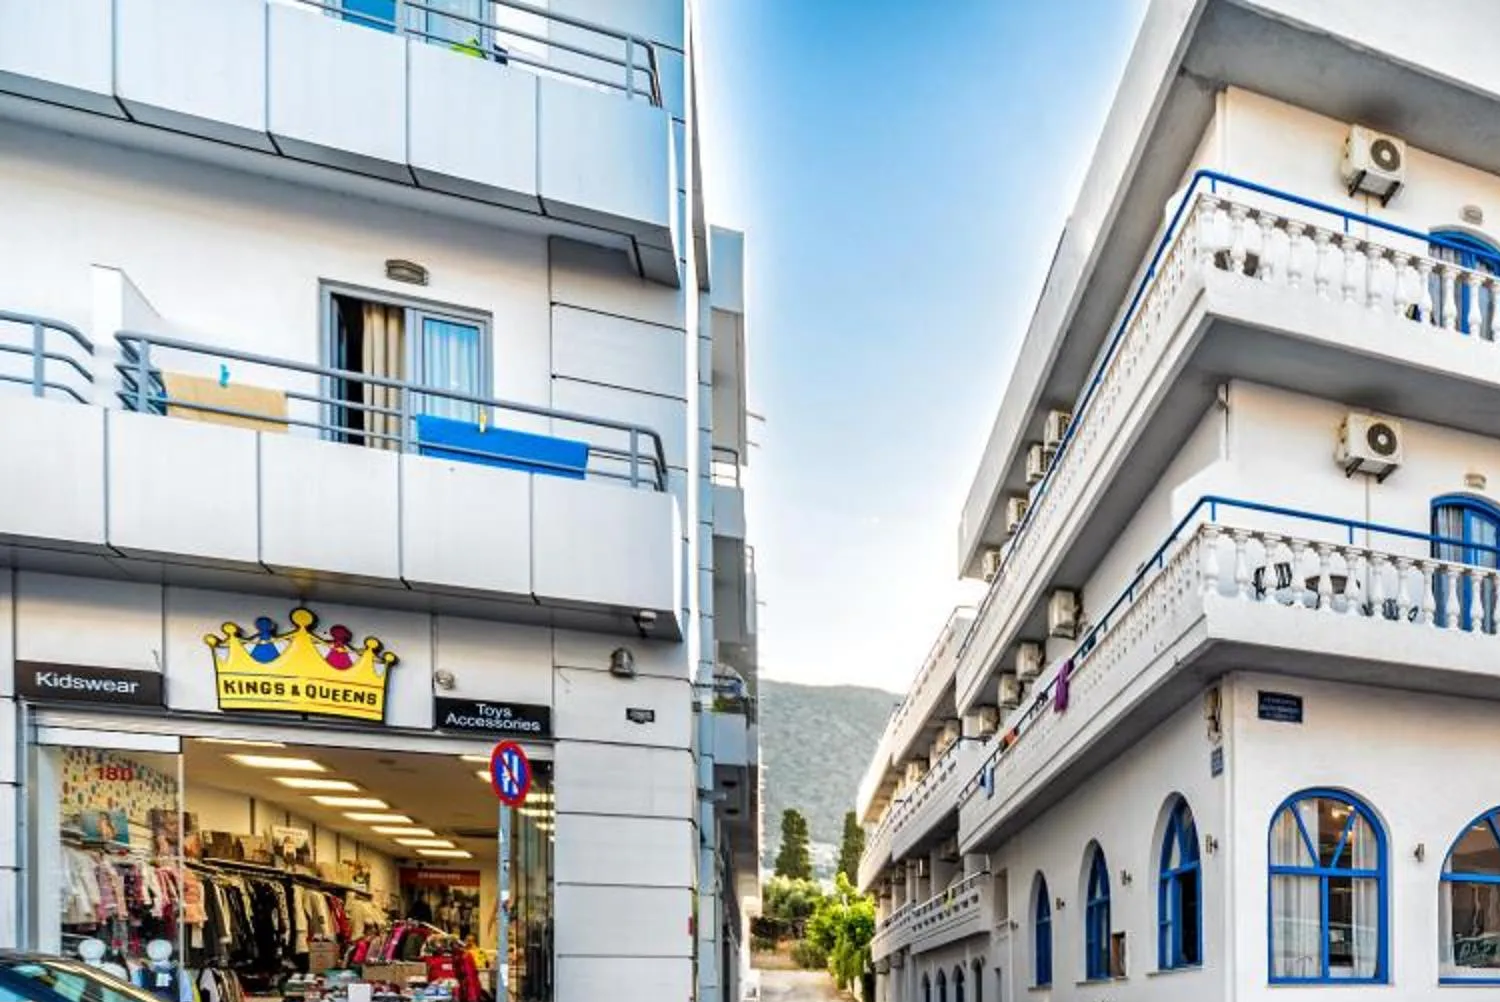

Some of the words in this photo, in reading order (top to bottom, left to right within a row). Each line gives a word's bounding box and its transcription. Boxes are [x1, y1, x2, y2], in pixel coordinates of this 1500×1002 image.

[35, 671, 139, 694] Kidswear
[223, 680, 285, 695] KINGS
[291, 685, 300, 696] &
[305, 684, 377, 705] QUEENS
[476, 703, 512, 718] Toys
[445, 713, 541, 732] Accessories
